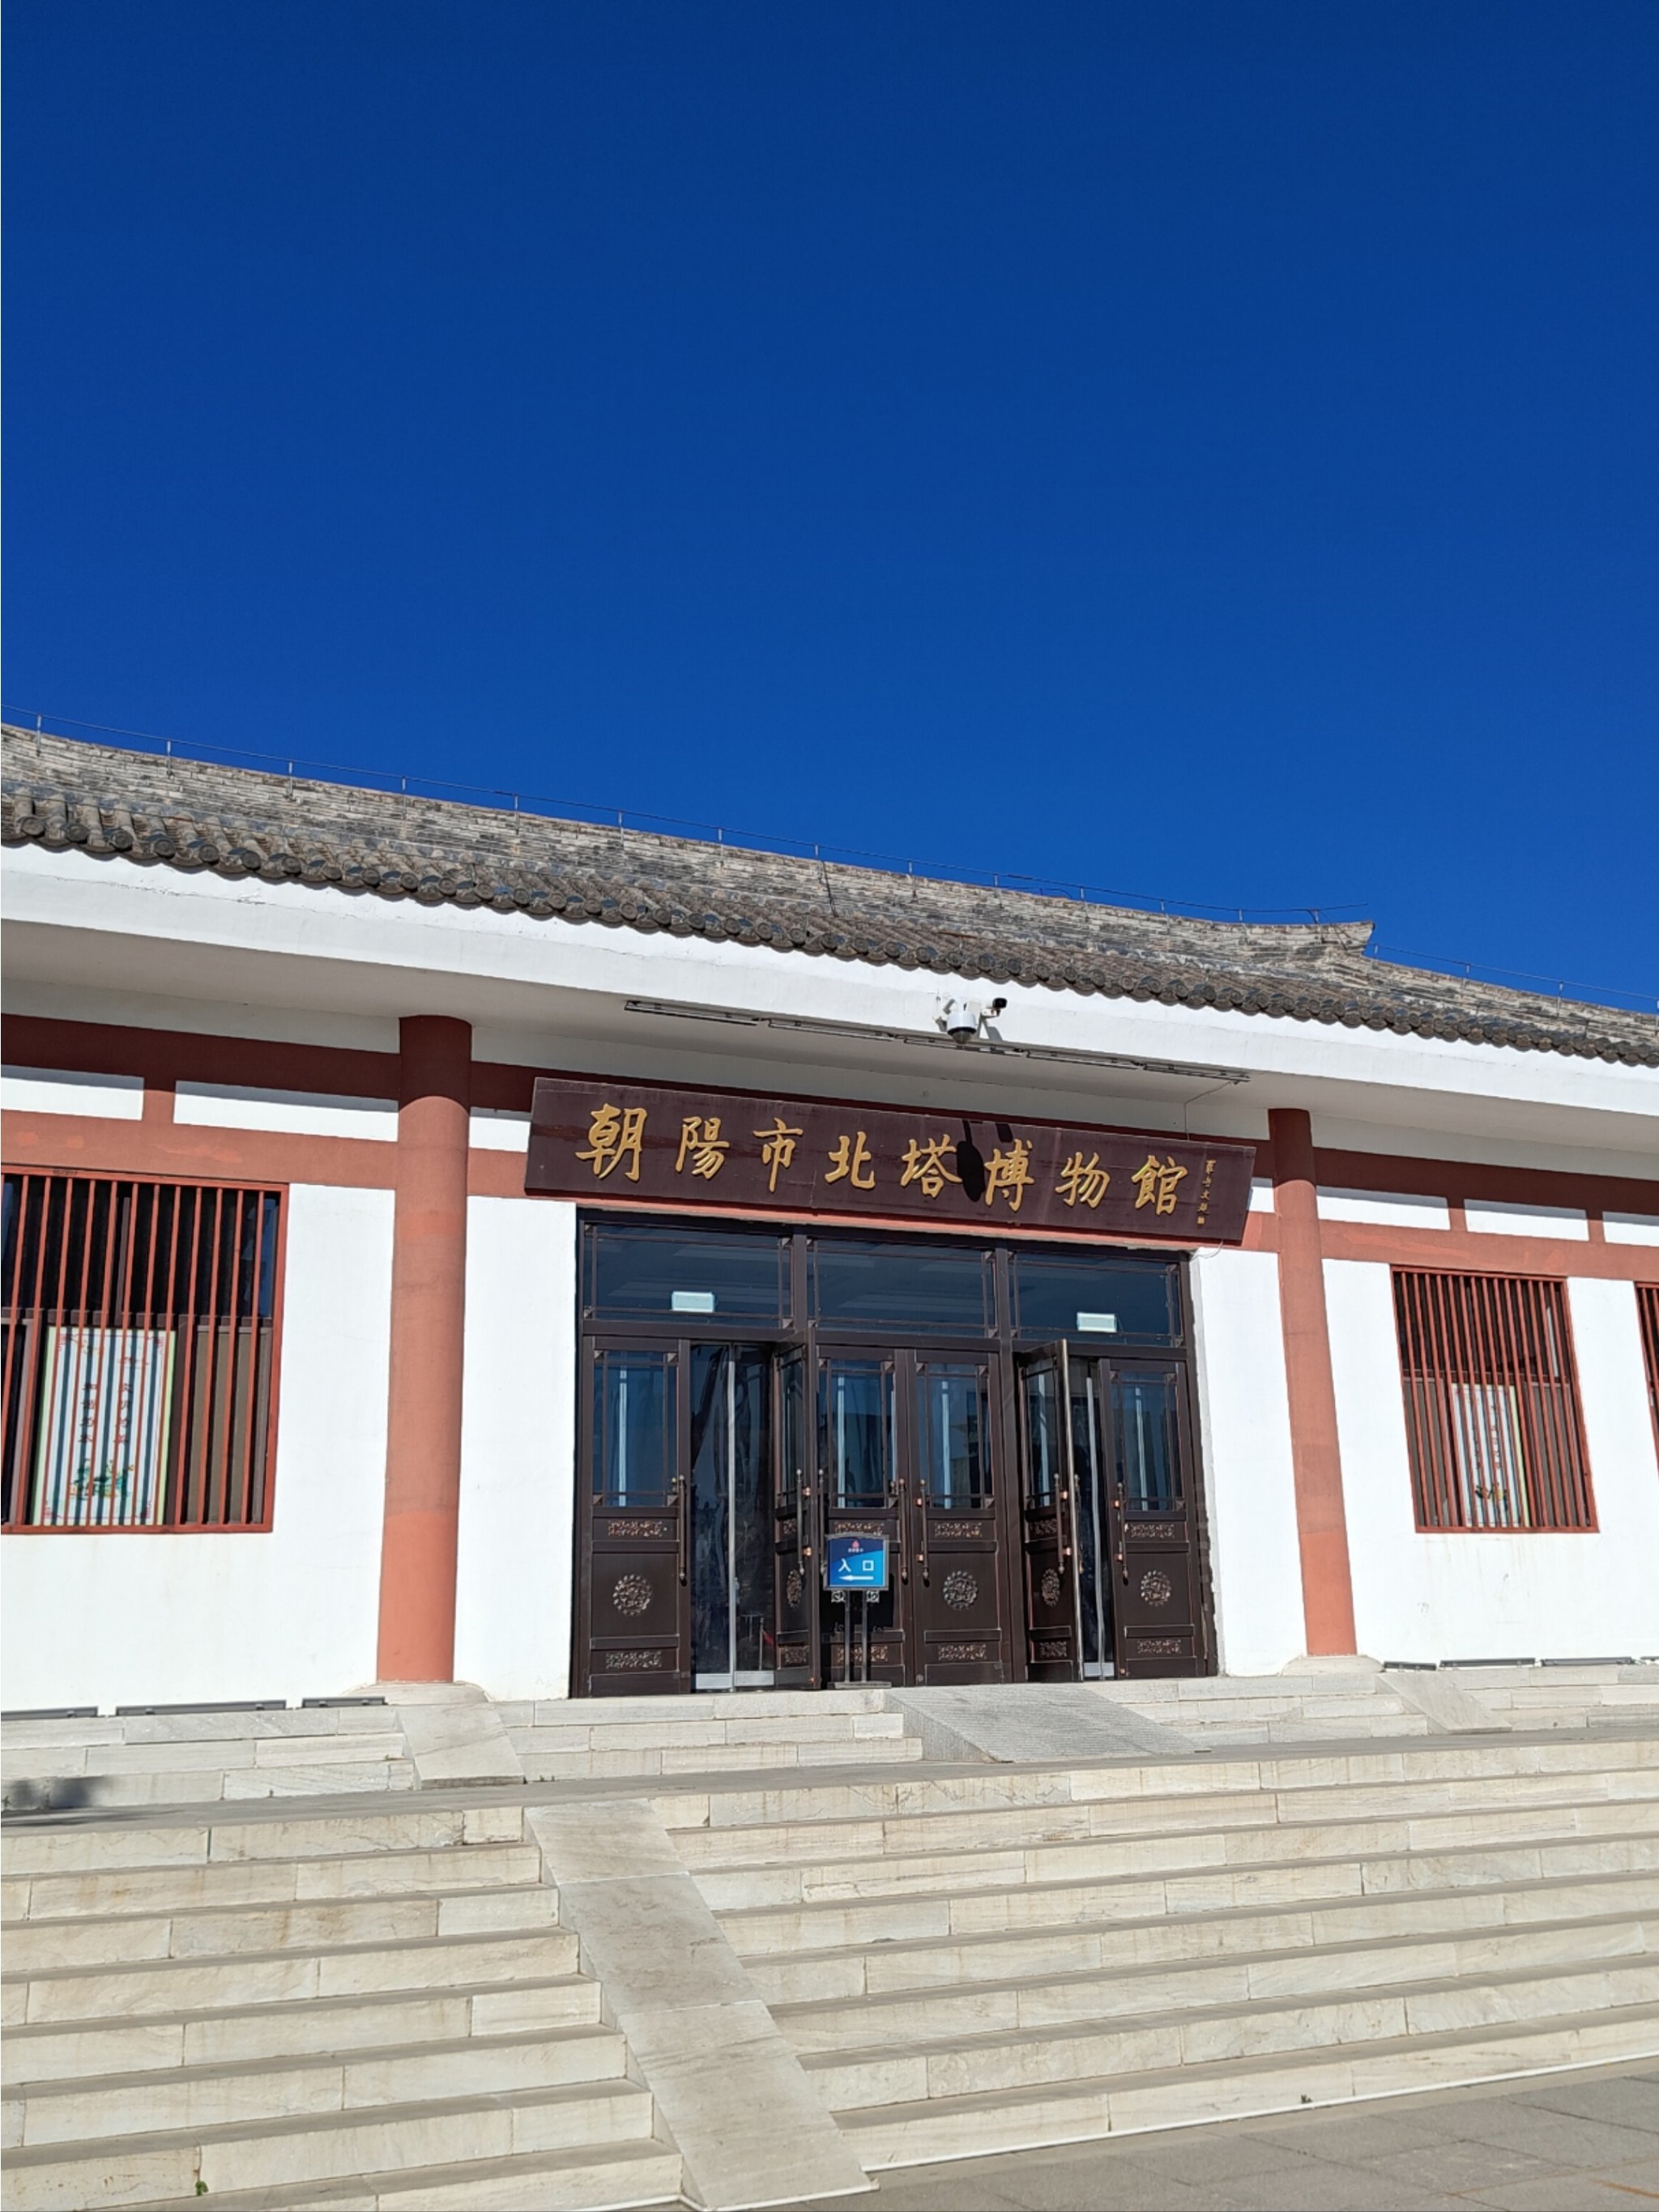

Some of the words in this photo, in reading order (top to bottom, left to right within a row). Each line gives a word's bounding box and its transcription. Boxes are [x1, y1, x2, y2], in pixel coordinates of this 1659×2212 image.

[574, 1102, 1188, 1215] 朝陽市北塔博物館
[838, 1558, 874, 1572] 入口
